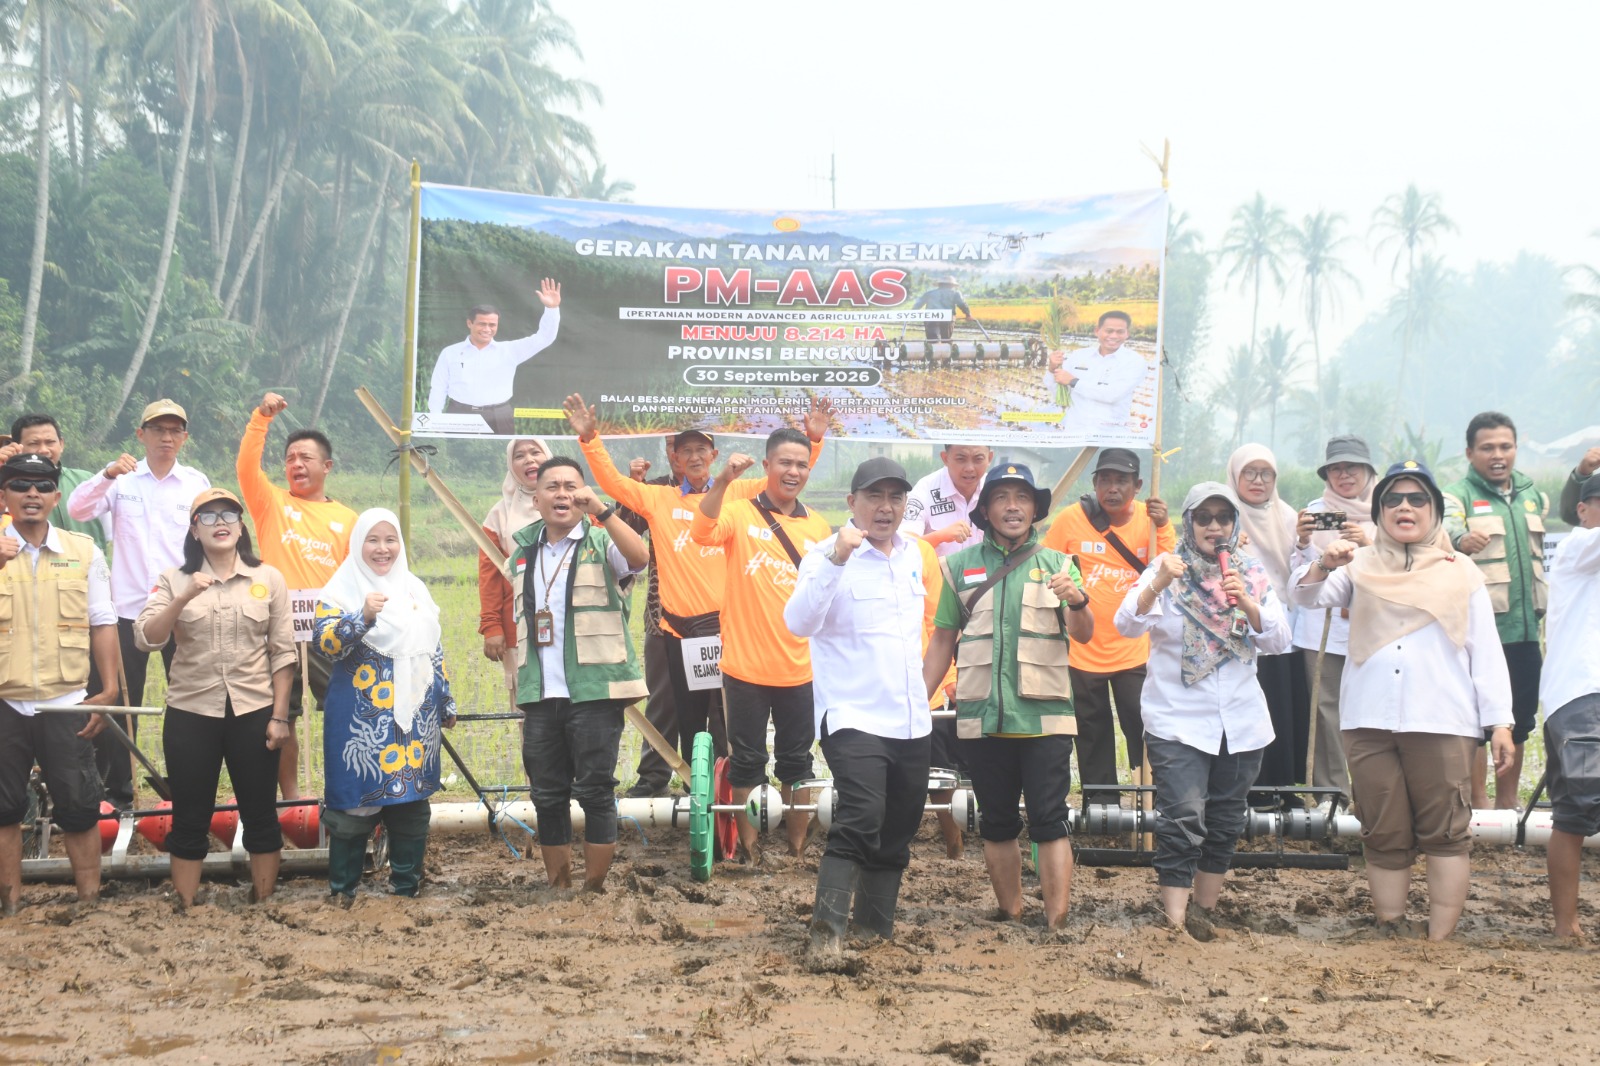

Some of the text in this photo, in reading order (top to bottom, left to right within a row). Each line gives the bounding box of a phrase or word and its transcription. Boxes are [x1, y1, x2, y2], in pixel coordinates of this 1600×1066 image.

[575, 239, 1001, 261] GERAKAN TANAM SEREMPAK
[664, 266, 907, 307] PM-AAS
[626, 310, 945, 321] (PERTANIAN MODERN ADVANCED AGRICULTURAL SYSTEM)
[681, 324, 887, 342] MENUJU 8.214 HA
[668, 345, 900, 361] PROVINSI BENGKULU
[695, 369, 870, 384] 30 September 2026
[600, 394, 634, 403] BALAI
[637, 395, 675, 404] BESAR
[678, 396, 748, 405] PENERAPAN
[833, 398, 900, 406] PERTANIAN
[903, 397, 966, 406] BENGKULU
[632, 405, 657, 413] DAN
[660, 406, 721, 414] PENYULUH
[724, 407, 791, 415] PERTANIAN
[870, 407, 933, 415] BENGKULU
[932, 503, 954, 514] TIFEN
[693, 663, 721, 678] REJANG
